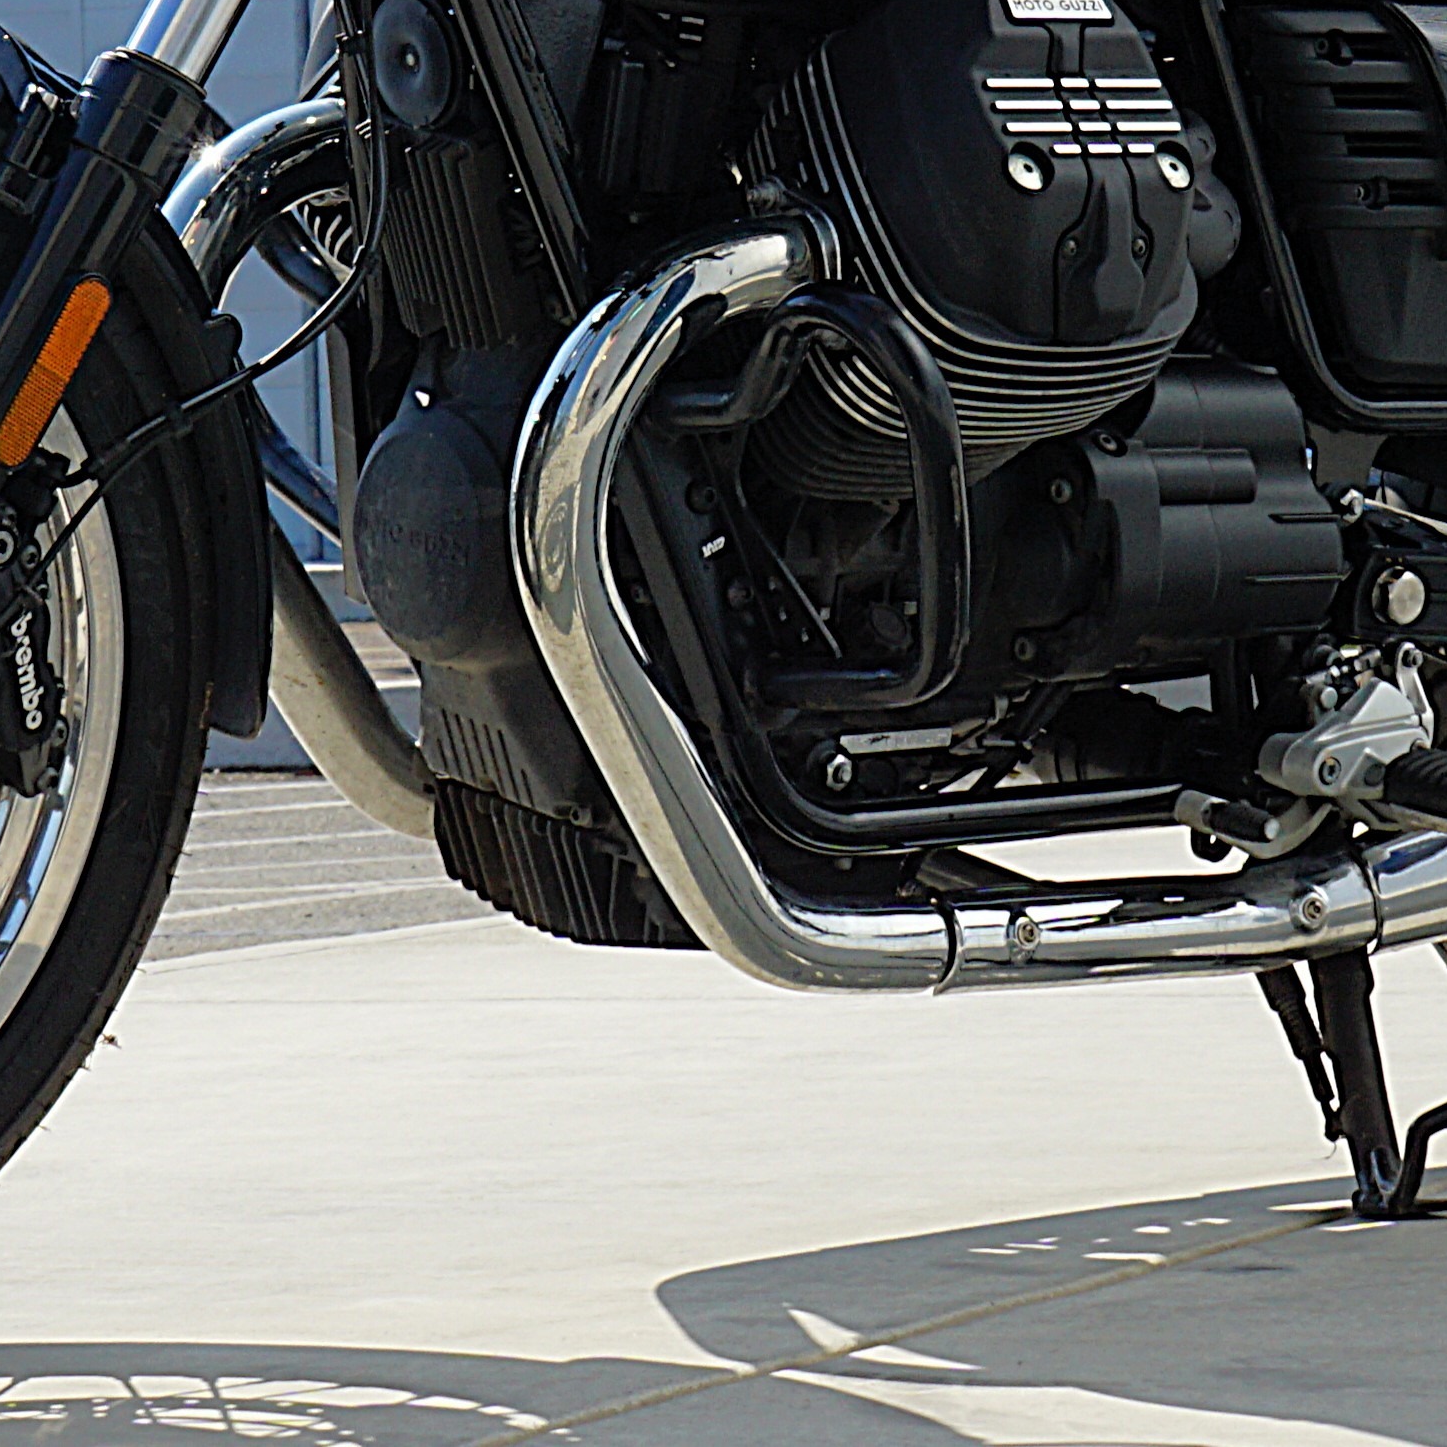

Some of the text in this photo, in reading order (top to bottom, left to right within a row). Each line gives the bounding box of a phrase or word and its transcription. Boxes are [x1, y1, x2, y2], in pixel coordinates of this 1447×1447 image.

[1012, 0, 1104, 11] MOTO GUZZI
[11, 610, 45, 731] brembo
